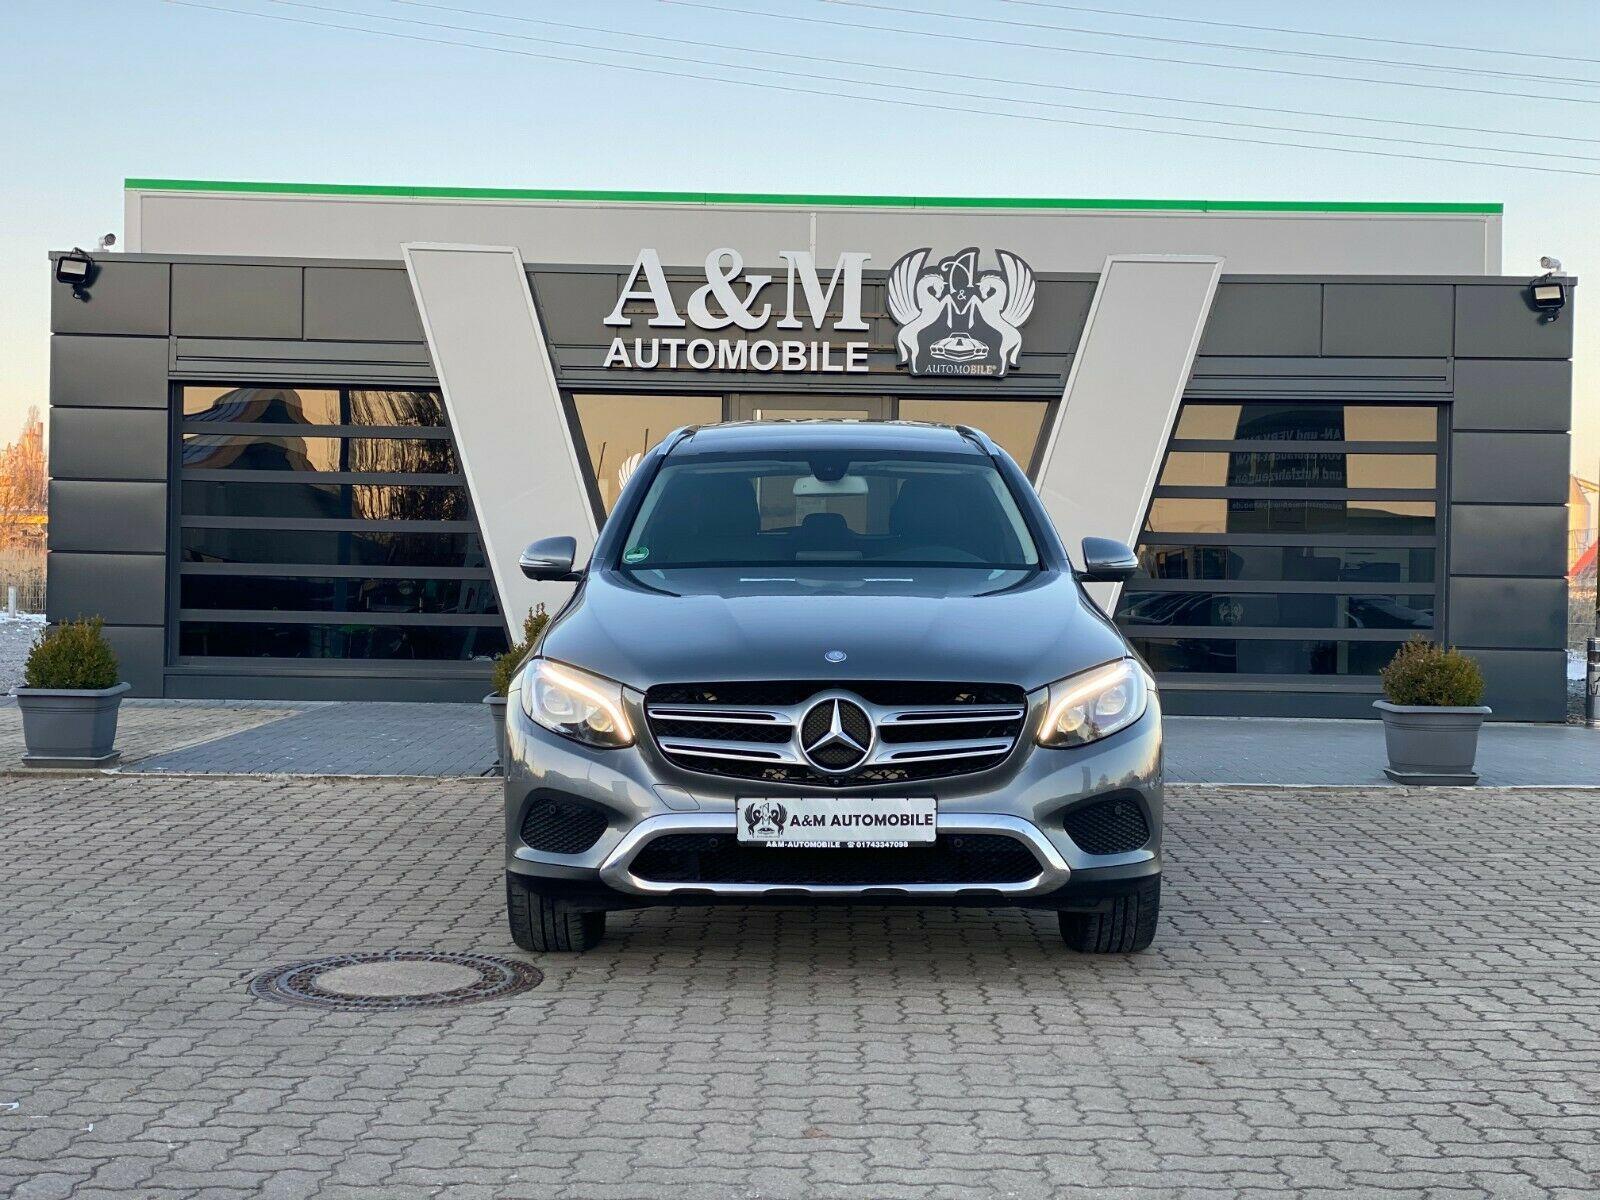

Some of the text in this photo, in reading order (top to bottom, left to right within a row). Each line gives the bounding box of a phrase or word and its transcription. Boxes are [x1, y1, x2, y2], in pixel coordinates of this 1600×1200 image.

[603, 247, 872, 331] A&M
[603, 337, 870, 373] AUTOMOBILE
[790, 813, 934, 827] A&M AUTOMOBILE
